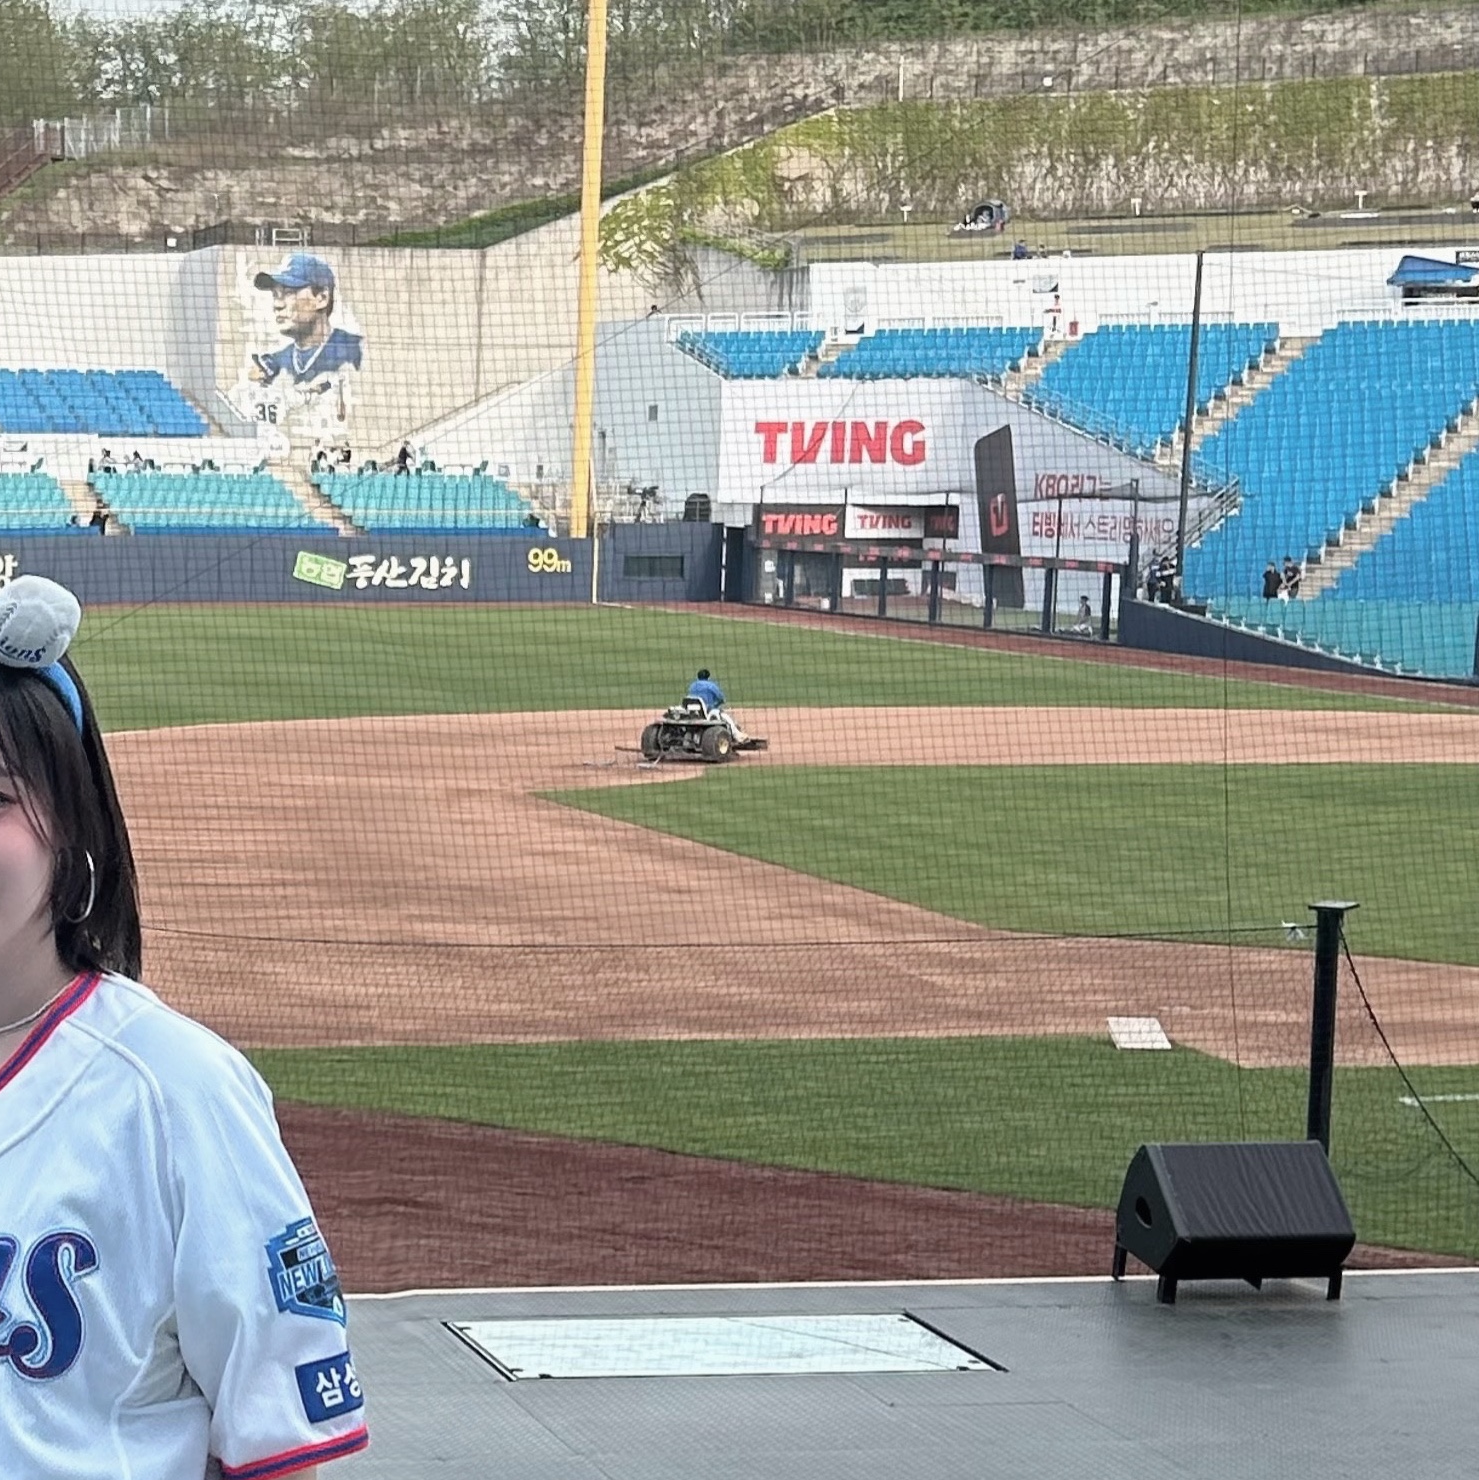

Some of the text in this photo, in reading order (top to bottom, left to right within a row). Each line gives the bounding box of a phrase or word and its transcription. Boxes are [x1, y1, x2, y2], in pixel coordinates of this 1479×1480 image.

[755, 420, 926, 465] TVING
[762, 513, 838, 536] TVING
[857, 514, 913, 530] TVING
[346, 554, 470, 590] 풍산김치
[527, 548, 572, 573] 99m
